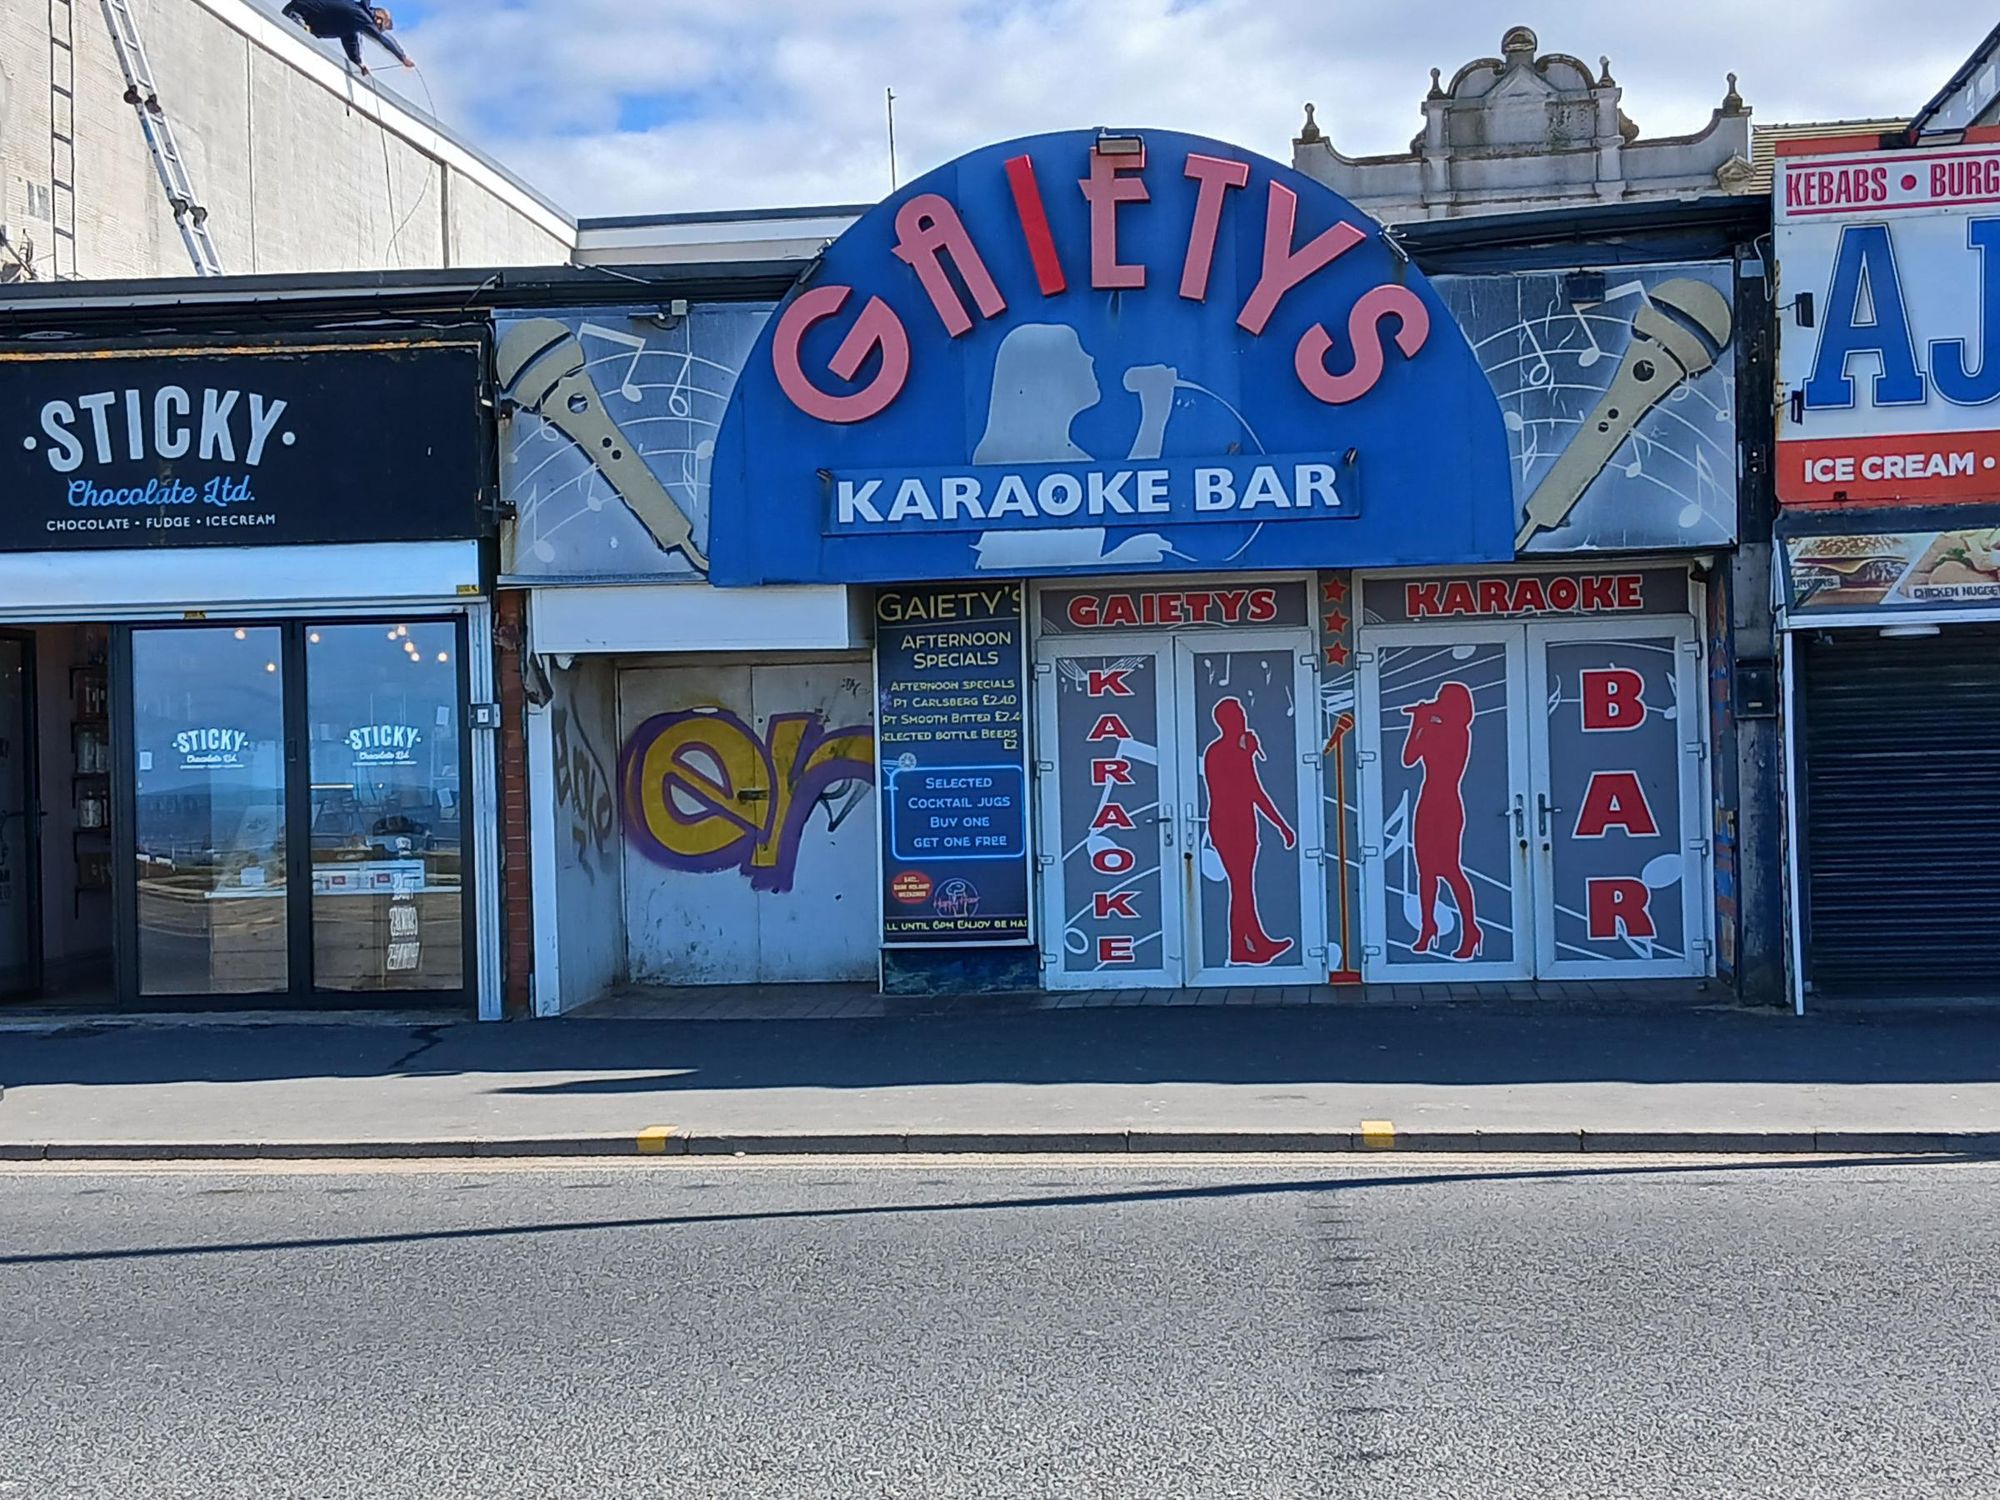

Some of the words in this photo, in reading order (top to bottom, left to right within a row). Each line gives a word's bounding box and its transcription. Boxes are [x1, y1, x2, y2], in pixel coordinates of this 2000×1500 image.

[1786, 166, 1887, 207] KEBABS
[772, 145, 1430, 423] GAIETYS
[40, 385, 288, 473] STICKY
[1804, 457, 1855, 483] ICE
[1861, 452, 1975, 480] CREAM
[67, 478, 198, 507] Chocolate
[203, 475, 256, 507] Ltd.
[836, 468, 1170, 525] KARAOKE
[1194, 464, 1341, 512] BAR
[46, 518, 130, 531] CHOCOLATE
[146, 516, 191, 529] FUDGE
[206, 514, 276, 526] ICECREAM
[1406, 575, 1645, 618] KARAOKE
[1068, 590, 1278, 627] GAIETYS
[900, 631, 1012, 650] AFTERNOON
[913, 651, 999, 669] SPECIALS
[890, 681, 959, 692] AFTERNOON
[962, 679, 1015, 690] SPECIALS
[912, 697, 978, 708] CARLSBERG
[900, 713, 948, 725] SMOOTH
[951, 712, 991, 723] BITTER
[177, 728, 246, 753] STICKY
[349, 725, 418, 750] STICKY
[935, 730, 978, 741] BOTTLE
[981, 728, 1018, 739] BEERS
[925, 777, 993, 789] SELECTED
[908, 797, 973, 809] COCKTAIL
[977, 796, 1011, 807] JUGS
[1571, 667, 1661, 941] BAR
[930, 816, 958, 828] BUY
[962, 816, 990, 827] ONE
[1086, 669, 1142, 963] KARAOKE
[913, 837, 939, 848] GET
[943, 836, 971, 847] ONE
[975, 835, 1007, 846] FREE
[901, 922, 930, 931] UNTIL
